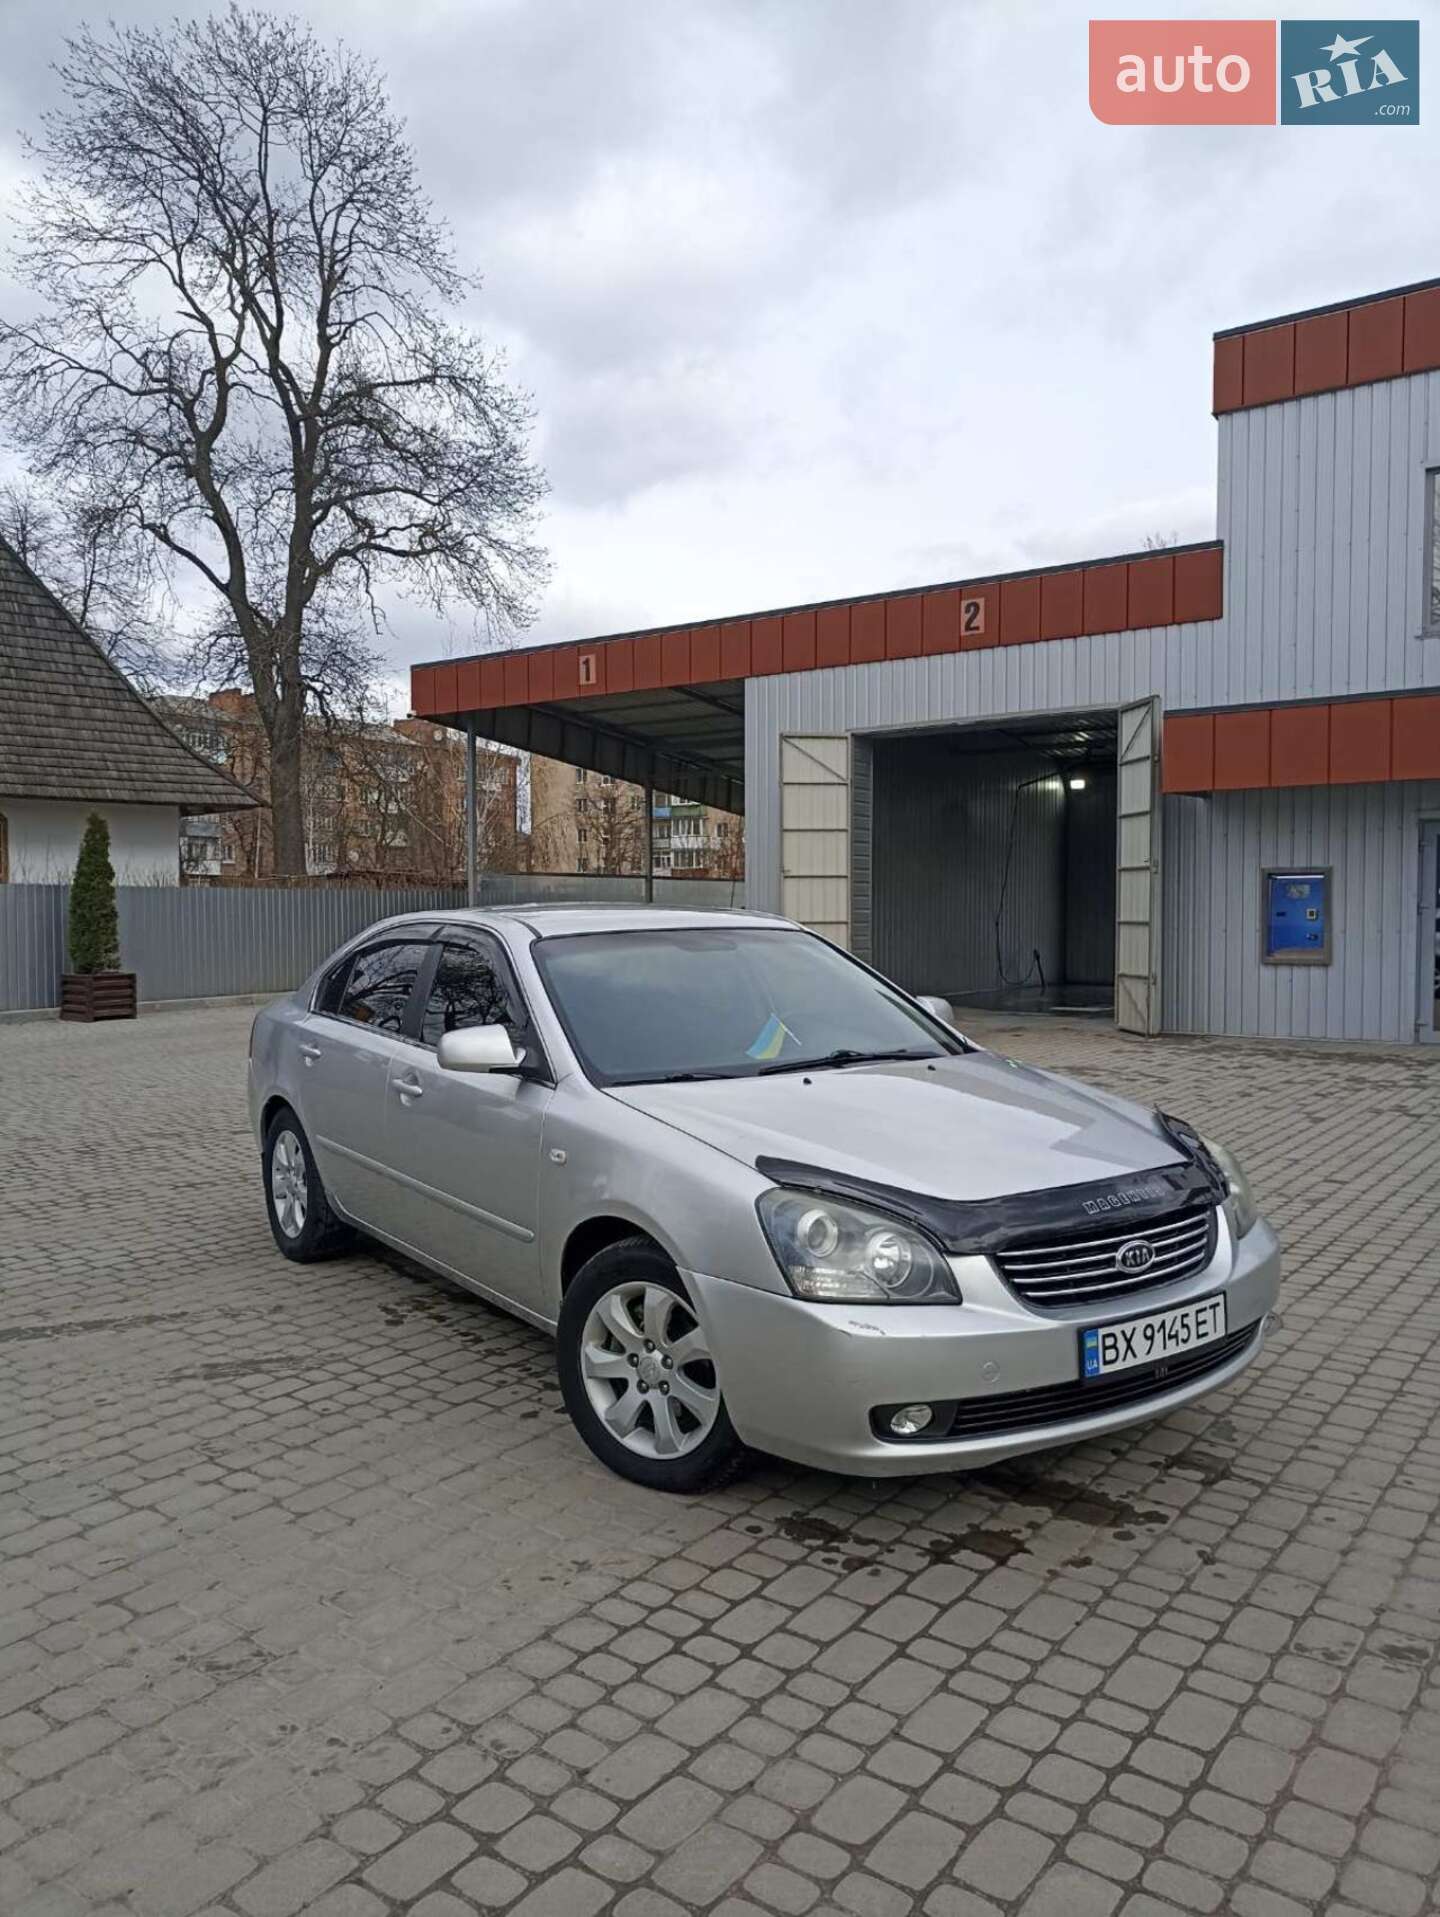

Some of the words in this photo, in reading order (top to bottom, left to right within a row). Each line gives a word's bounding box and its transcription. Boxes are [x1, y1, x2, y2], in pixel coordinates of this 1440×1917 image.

[963, 601, 981, 632] 2
[581, 657, 592, 683] 1
[1125, 1246, 1150, 1267] KIA
[1101, 1326, 1138, 1367] BX
[1142, 1311, 1191, 1355] 9145
[1195, 1301, 1221, 1341] ET
[1086, 1358, 1098, 1371] UA
